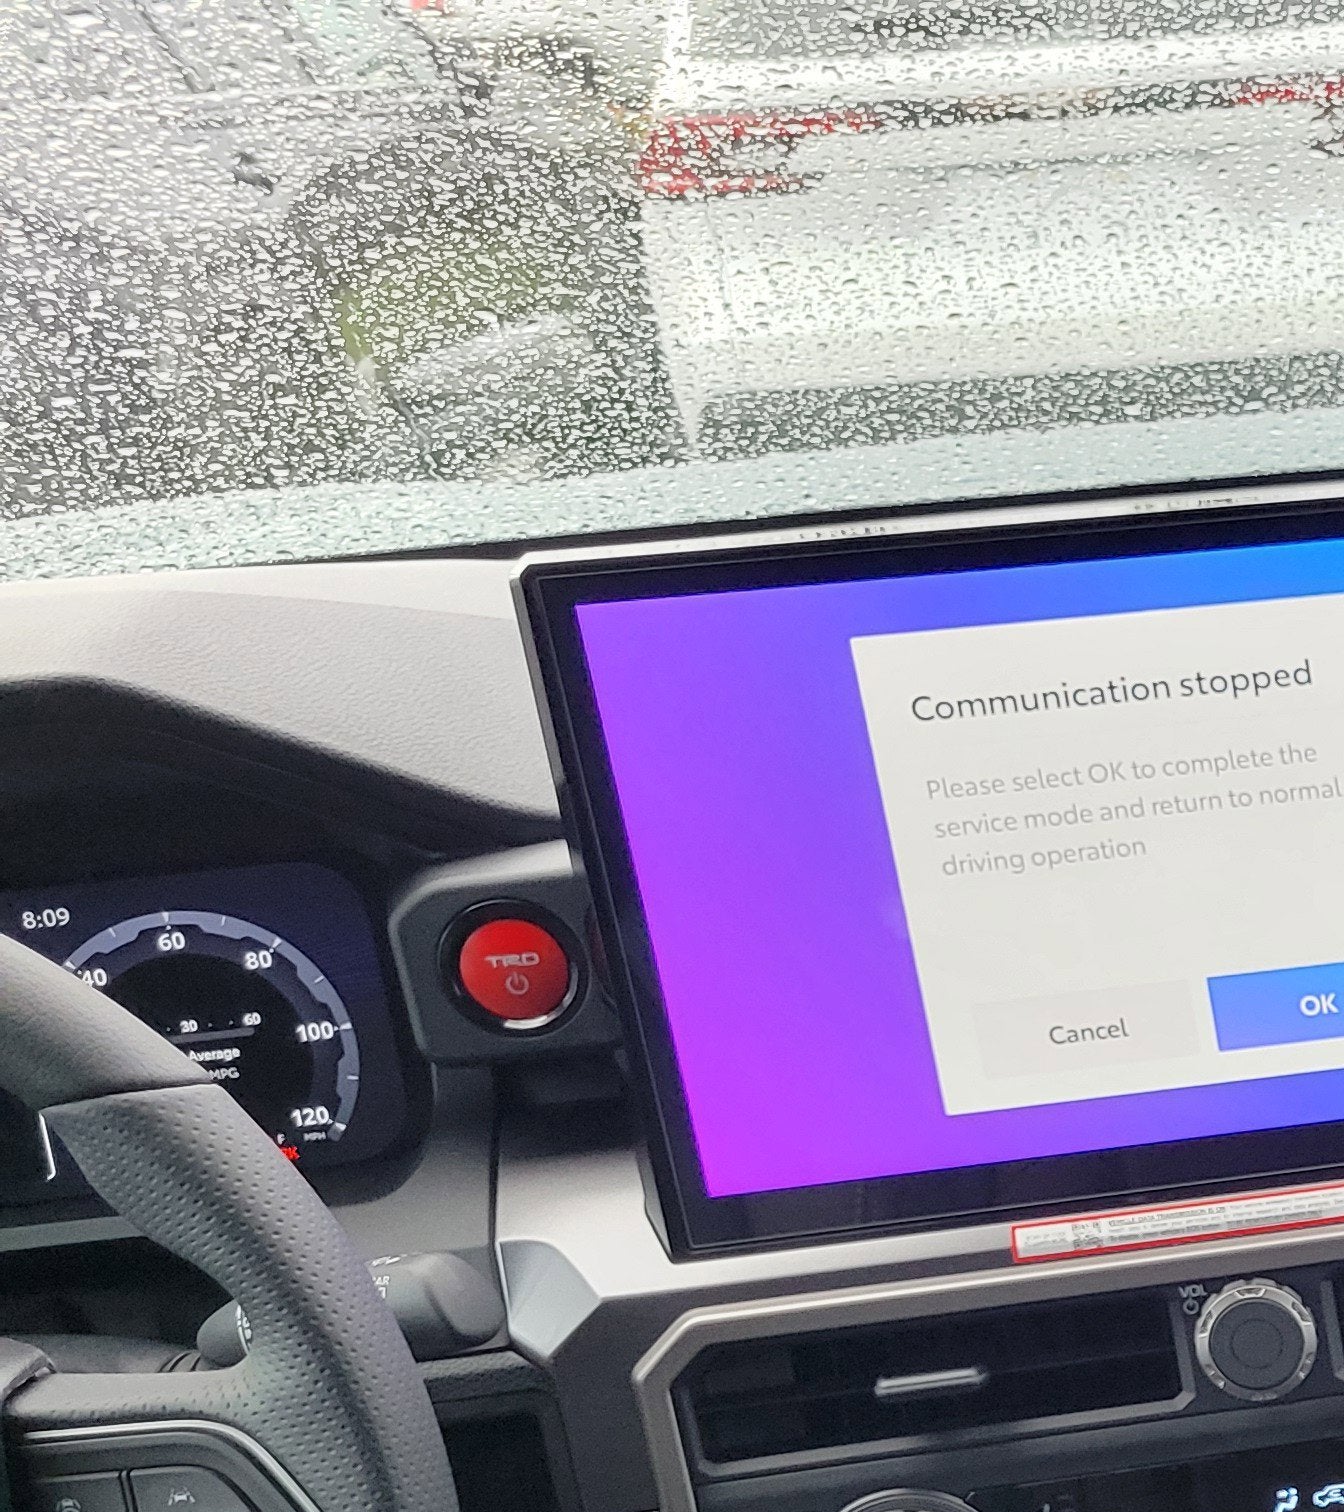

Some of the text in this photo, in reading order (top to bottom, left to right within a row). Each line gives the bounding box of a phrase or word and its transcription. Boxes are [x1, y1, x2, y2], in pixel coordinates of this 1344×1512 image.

[911, 659, 1313, 722] Communication stopped
[926, 743, 1318, 800] Please select OK to complete the
[934, 777, 1344, 839] service mode and return to normal
[942, 838, 1148, 877] driving operation
[21, 907, 71, 930] 8:09
[157, 931, 187, 951] 60
[244, 949, 273, 970] 80
[484, 951, 541, 969] TRD
[1299, 992, 1340, 1018] OK
[179, 1011, 262, 1034] 30 60
[295, 1020, 335, 1044] 100
[1048, 1017, 1130, 1046] Cancel
[188, 1047, 241, 1063] Average
[290, 1104, 331, 1127] 120
[1178, 1284, 1208, 1299] VOL
